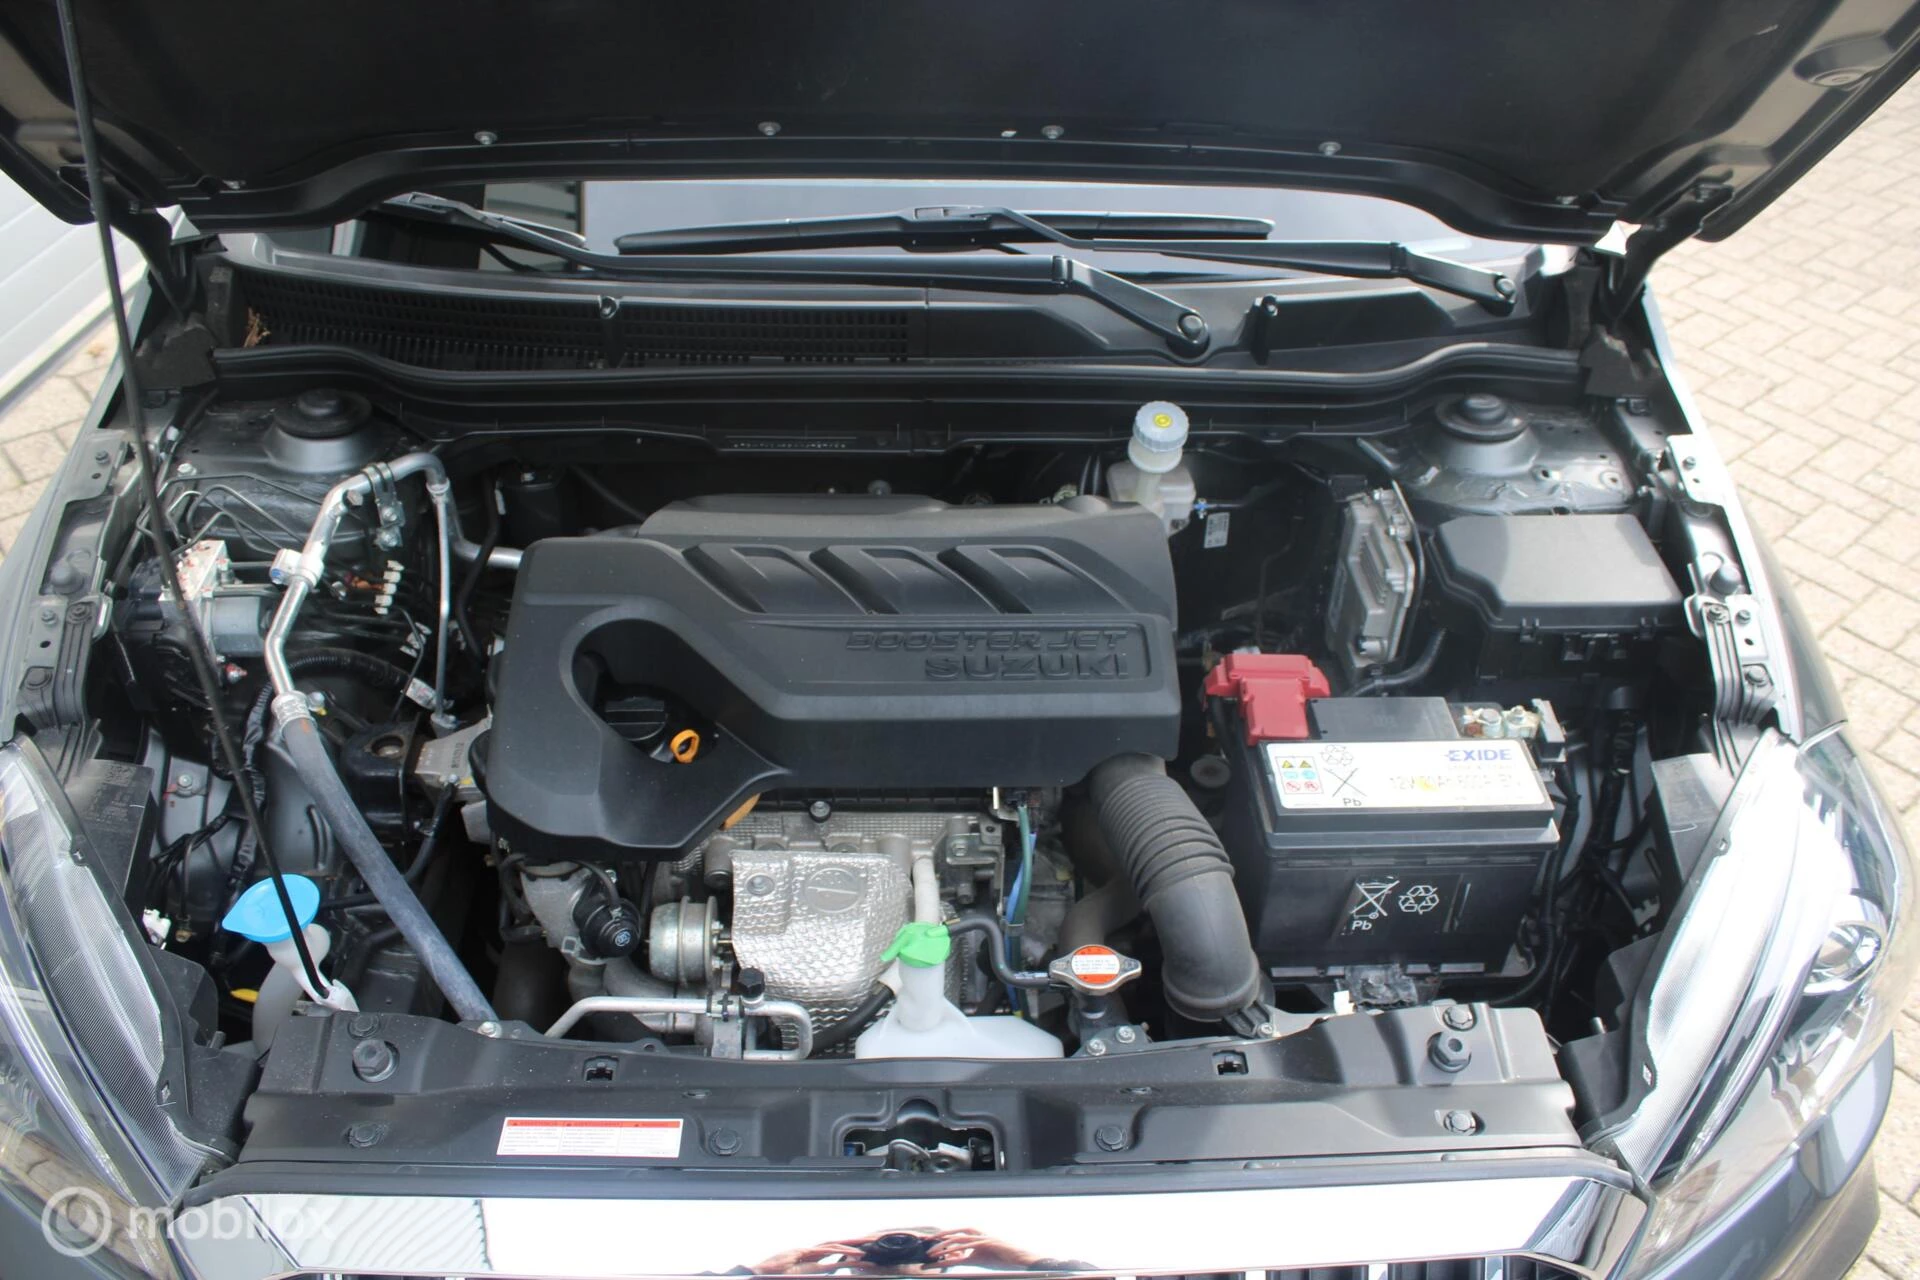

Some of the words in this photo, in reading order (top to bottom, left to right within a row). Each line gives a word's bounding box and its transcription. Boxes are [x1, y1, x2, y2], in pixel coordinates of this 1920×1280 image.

[846, 630, 1128, 650] BOOSTERJET
[925, 654, 1128, 680] SUZUKI
[1446, 749, 1512, 762] EXIDE
[1343, 797, 1362, 807] Pb
[1352, 920, 1372, 931] Pb
